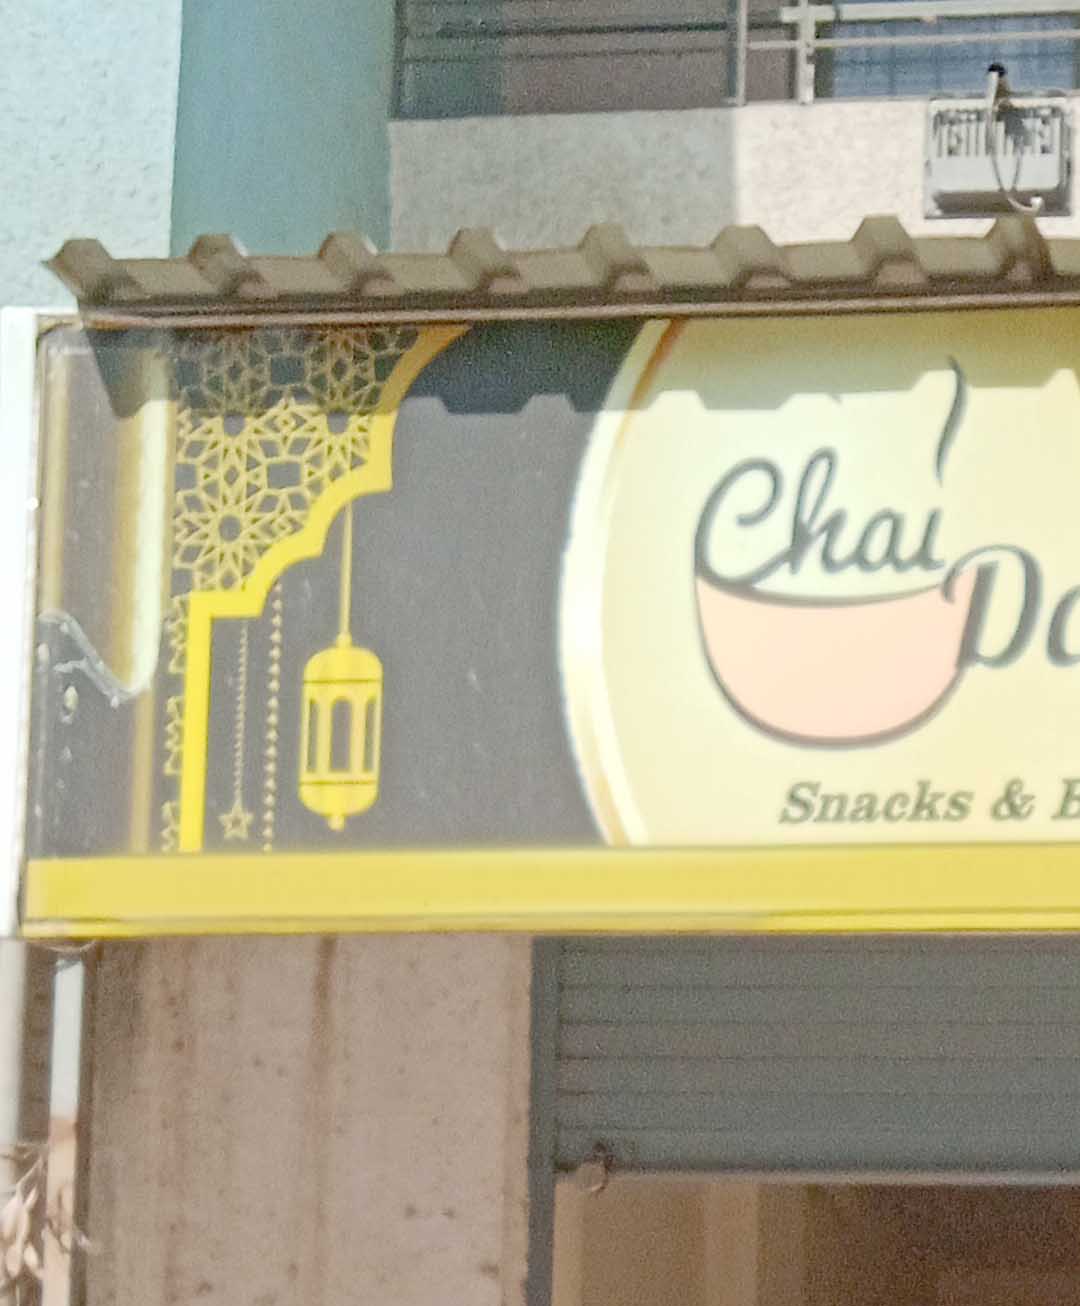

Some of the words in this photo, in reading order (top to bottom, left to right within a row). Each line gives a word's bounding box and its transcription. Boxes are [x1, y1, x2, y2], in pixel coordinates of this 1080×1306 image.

[692, 446, 945, 588] Chai
[777, 779, 974, 826] Snacks
[992, 777, 1034, 823] &
